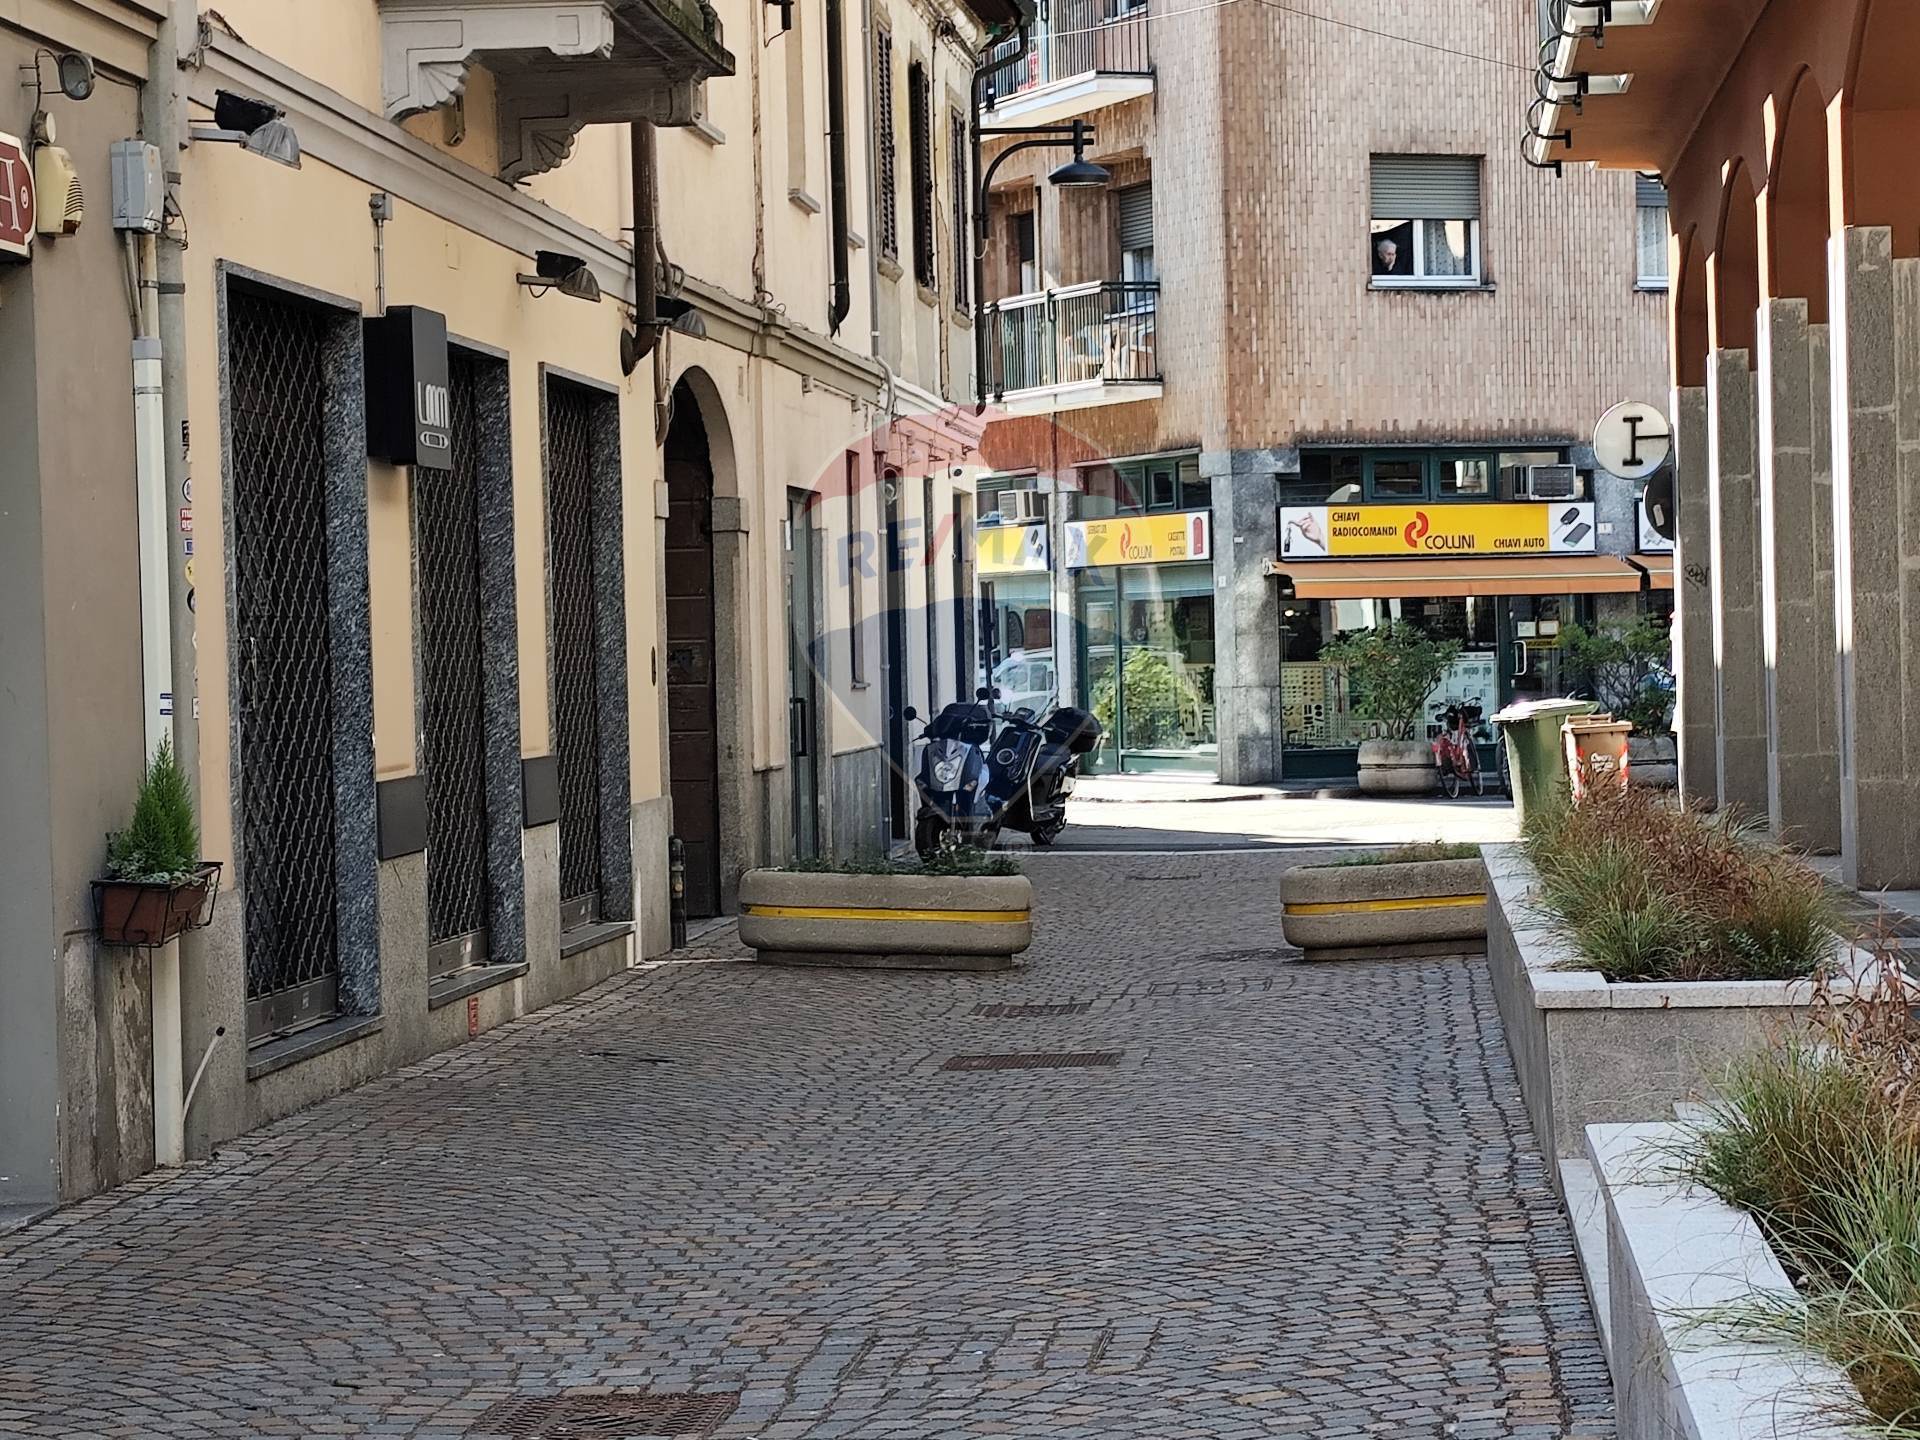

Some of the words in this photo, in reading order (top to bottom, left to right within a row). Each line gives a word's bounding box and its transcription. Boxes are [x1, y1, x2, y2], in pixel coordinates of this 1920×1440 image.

[1332, 511, 1360, 522] CHIAVI
[1332, 526, 1397, 537] RADIOCOMANDI
[1493, 537, 1521, 549] CHIAVI
[1524, 536, 1545, 549] AUTO
